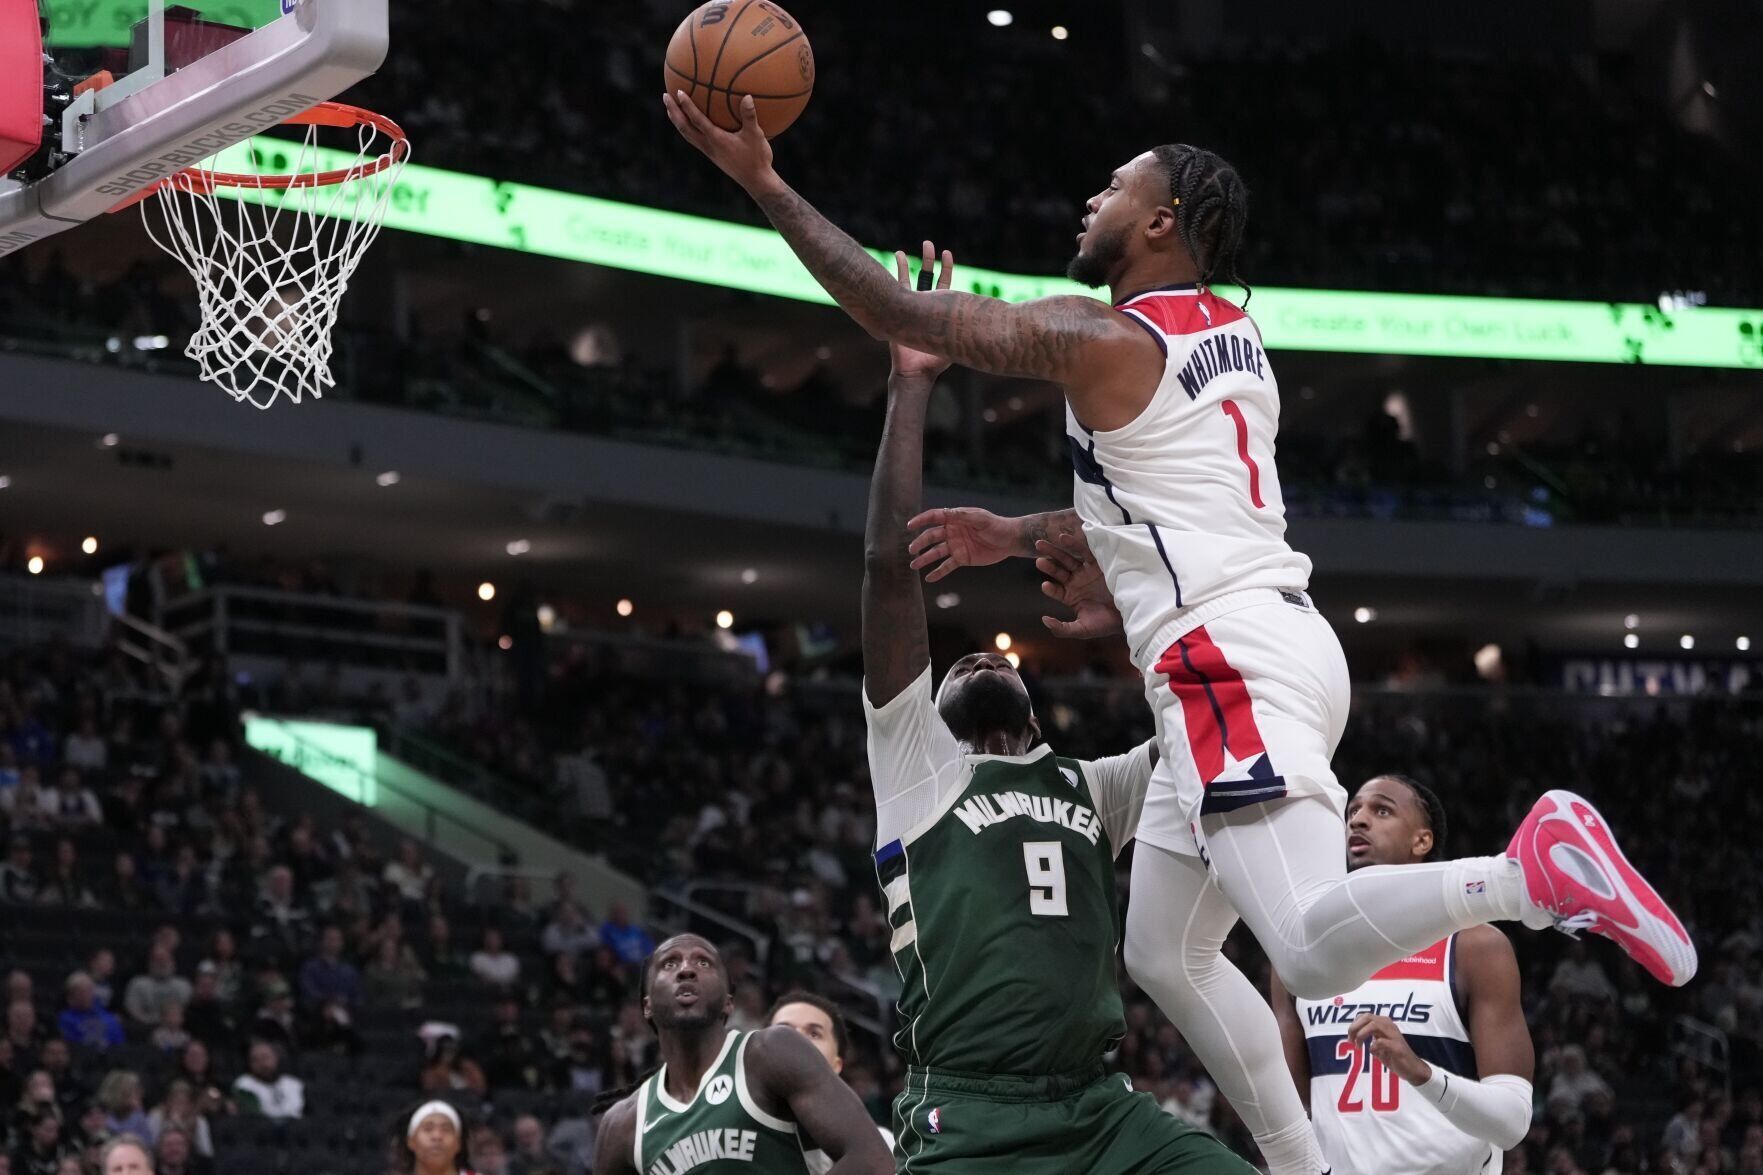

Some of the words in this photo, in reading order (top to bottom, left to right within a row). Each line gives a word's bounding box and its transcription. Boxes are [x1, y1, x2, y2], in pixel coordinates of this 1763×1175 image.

[95, 93, 319, 197] SHOP.BUCKS.COM
[1176, 333, 1264, 401] WHITMORE
[1221, 399, 1266, 508] 1
[953, 791, 1102, 847] MILWAUKEE
[1022, 841, 1068, 916] 9
[1307, 992, 1433, 1027] wizards
[1336, 1039, 1400, 1113] 20
[649, 1128, 757, 1175] ILWAUKEE
